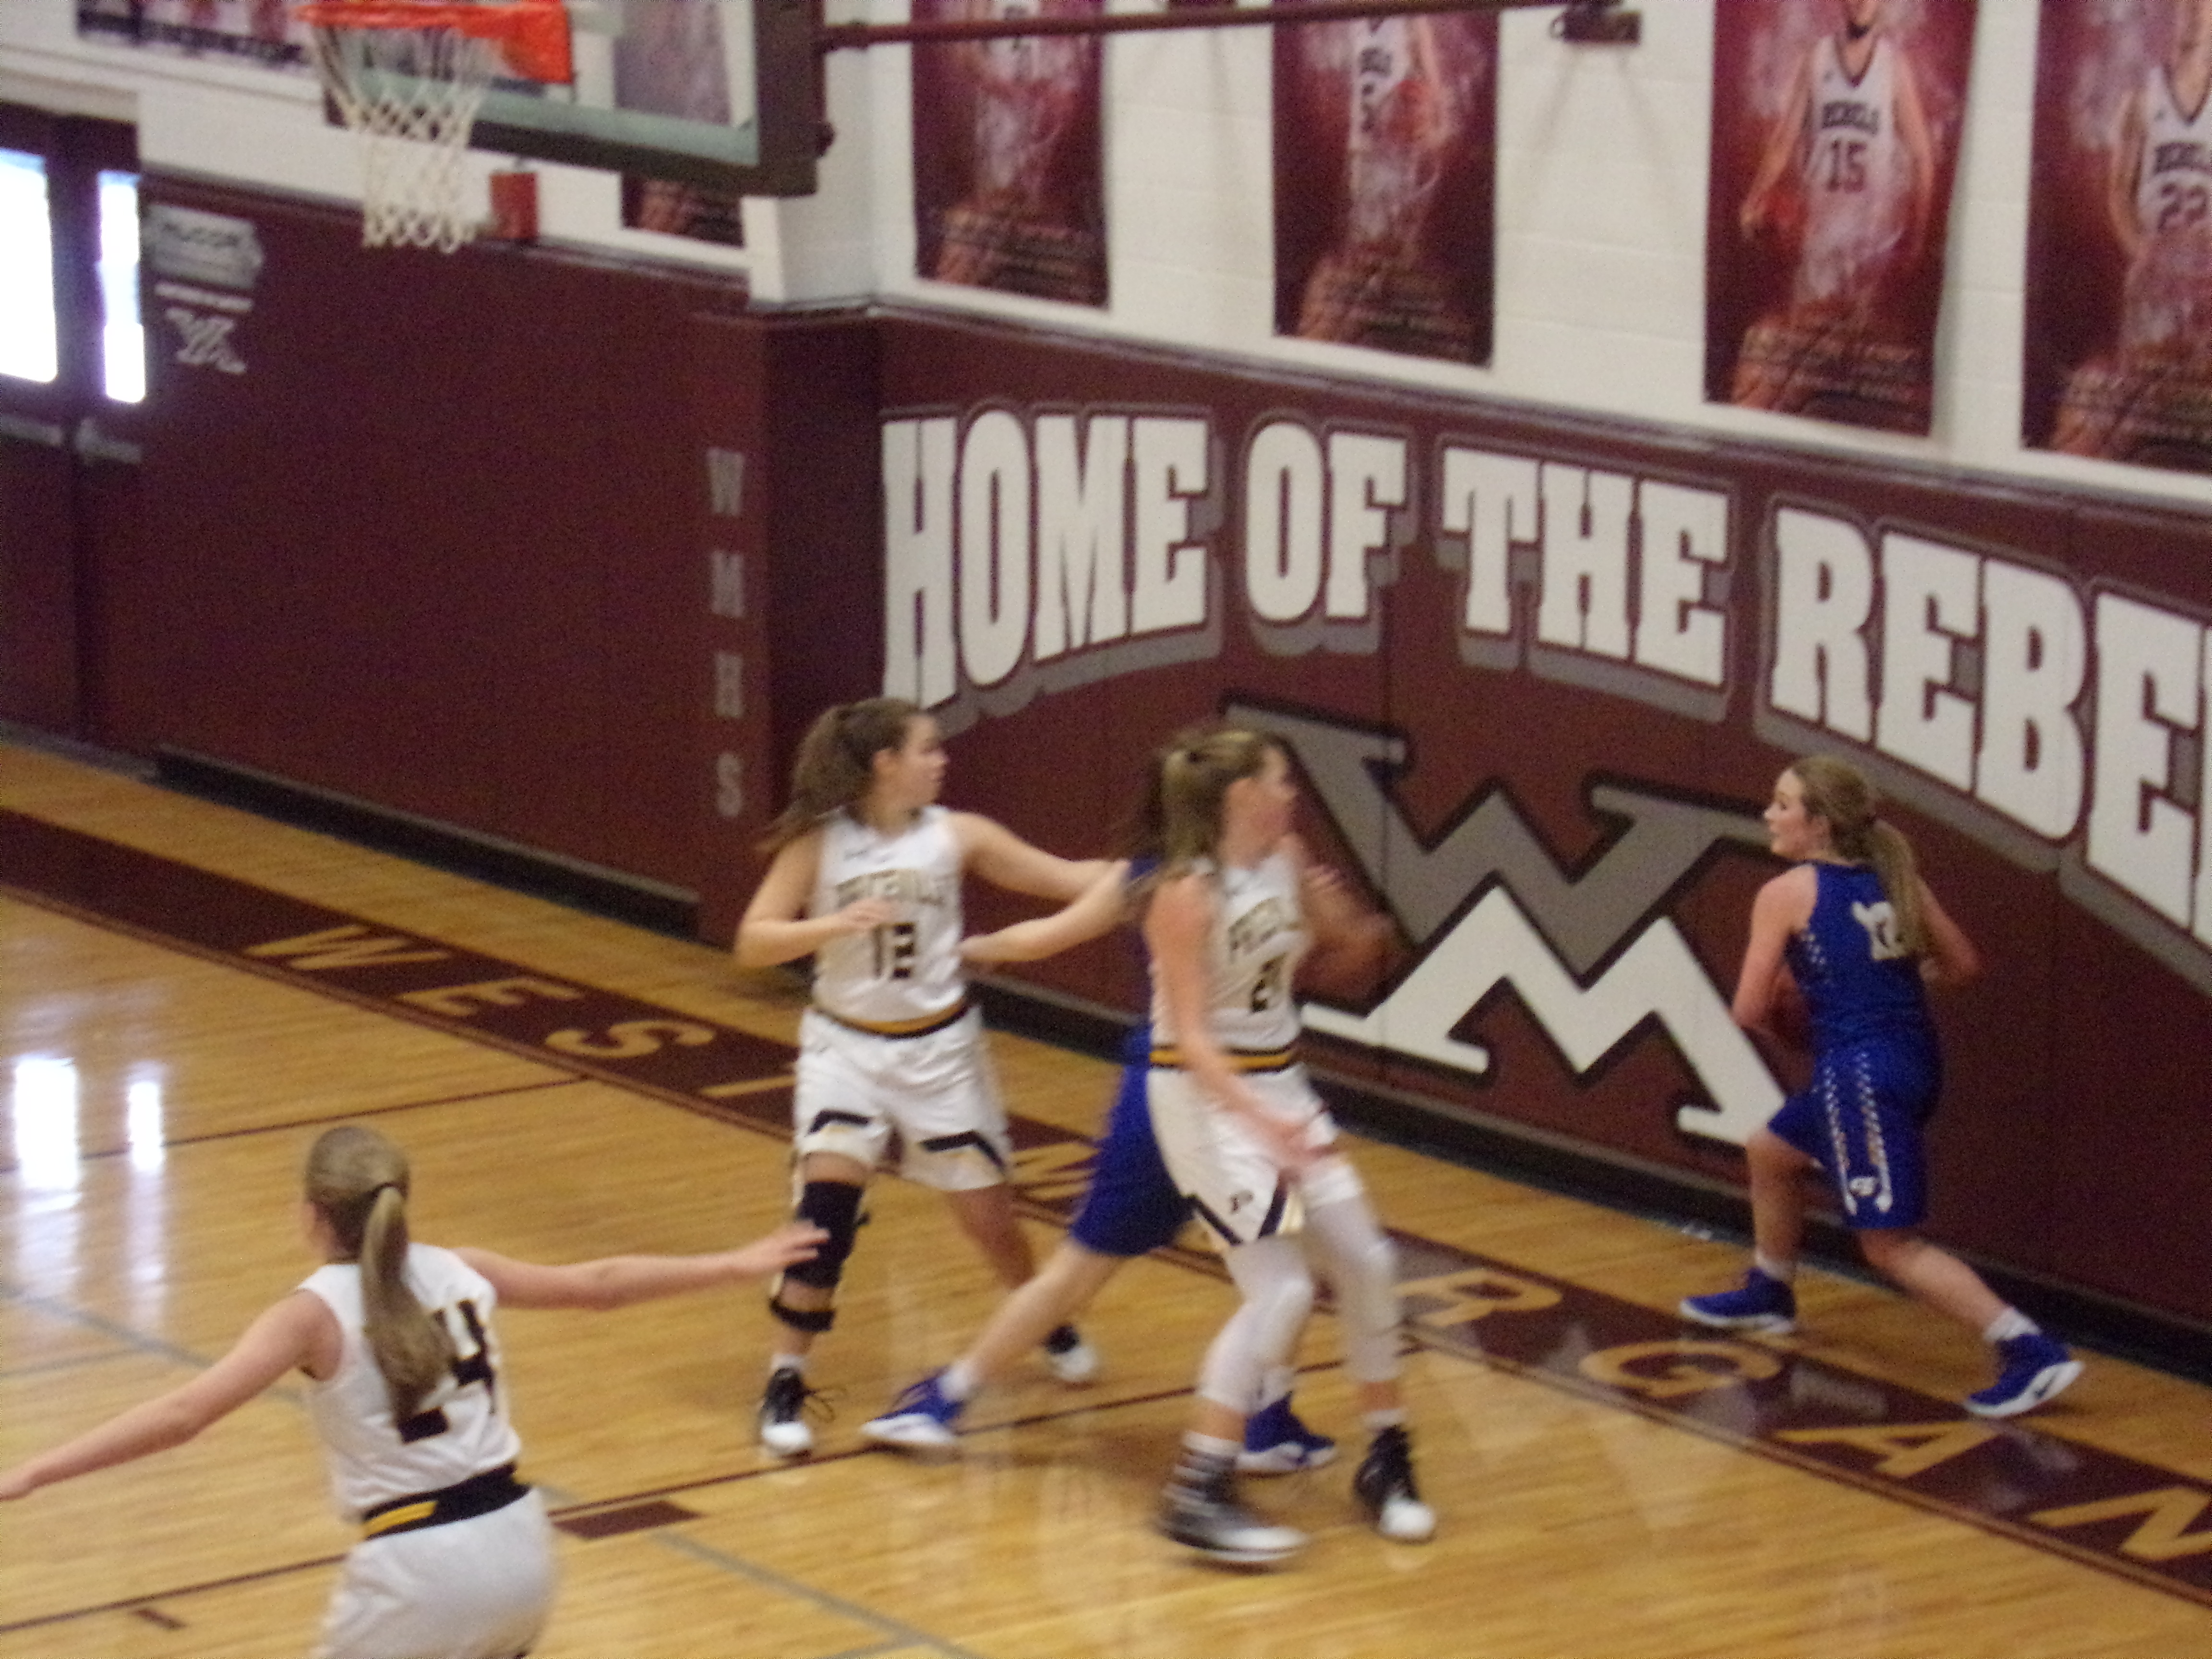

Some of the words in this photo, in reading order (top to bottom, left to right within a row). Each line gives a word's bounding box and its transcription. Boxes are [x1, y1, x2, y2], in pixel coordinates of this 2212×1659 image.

[1827, 138, 1867, 193] 15
[881, 410, 1208, 709] HOME
[1248, 421, 1407, 620] OF
[1443, 446, 1727, 686] THE
[1771, 507, 2212, 953] REBE
